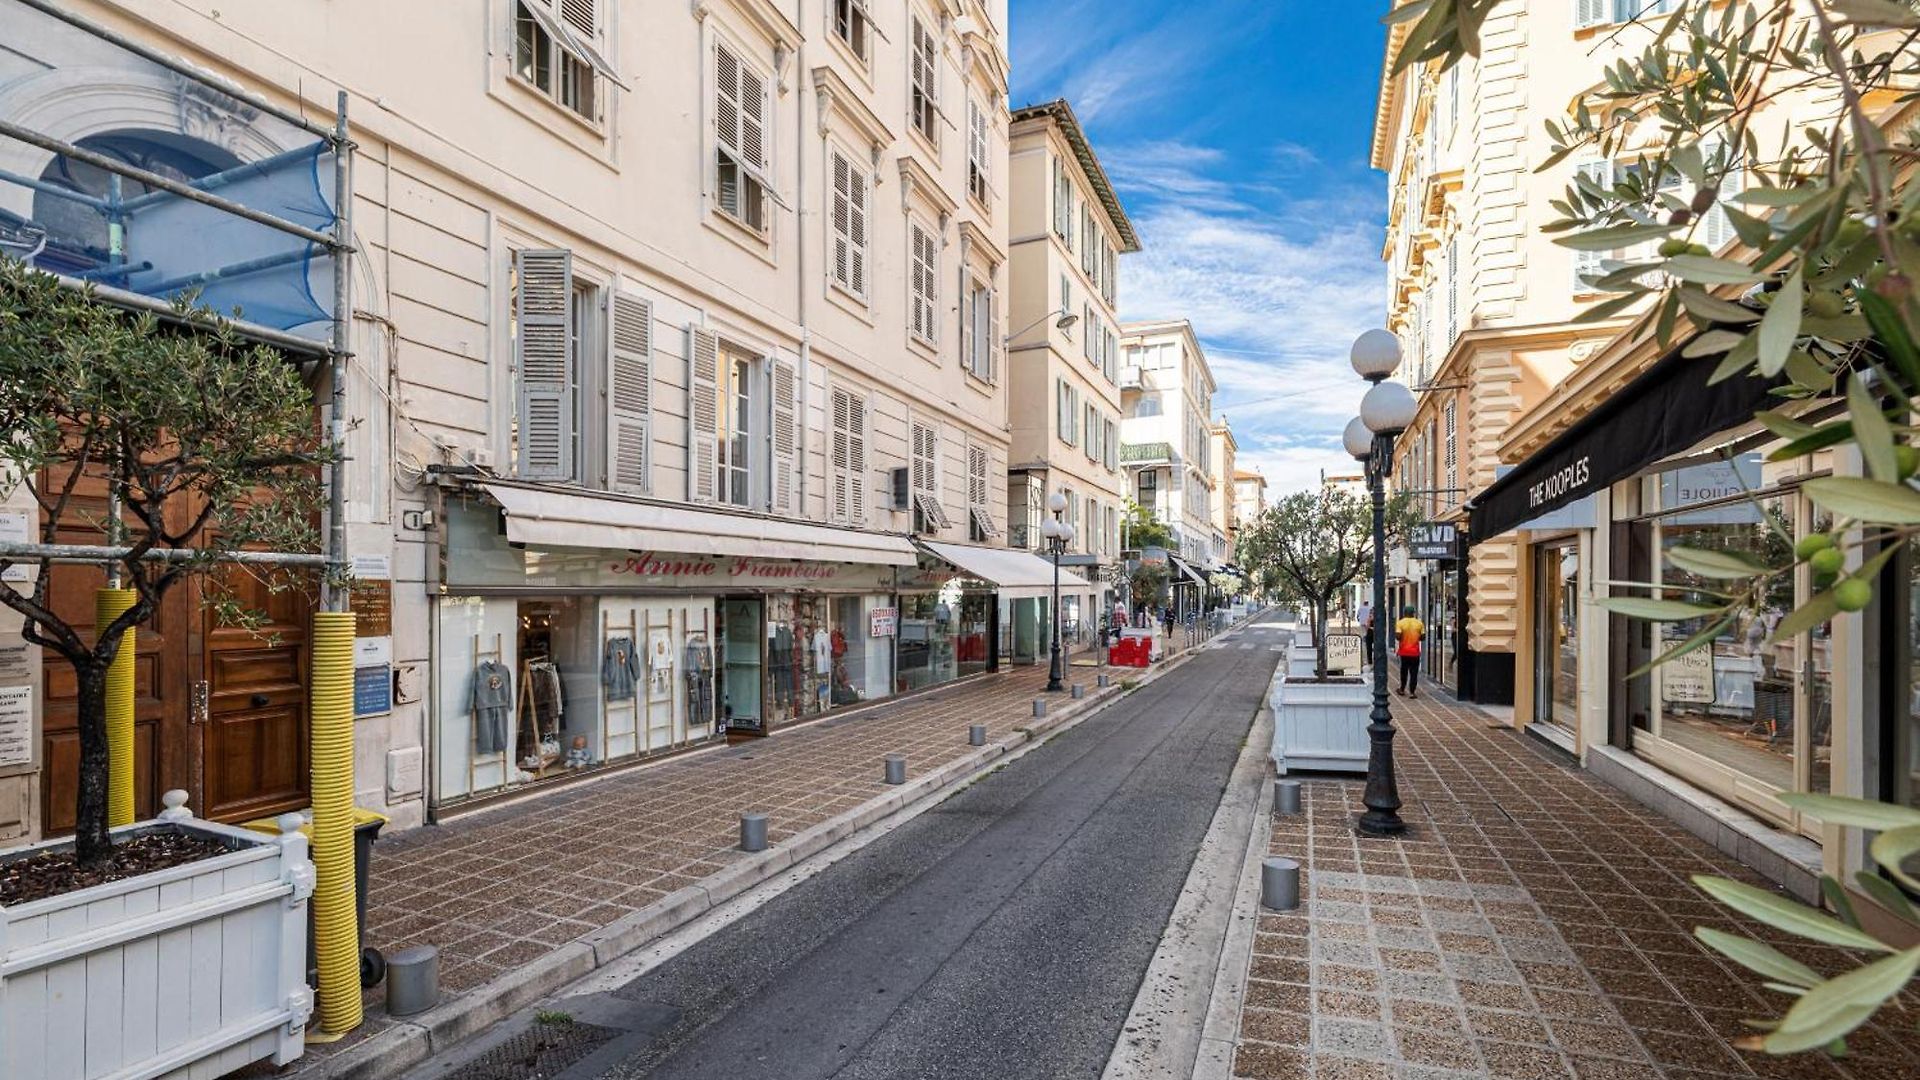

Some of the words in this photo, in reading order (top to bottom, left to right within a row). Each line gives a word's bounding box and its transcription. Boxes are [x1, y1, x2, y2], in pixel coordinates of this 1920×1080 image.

[1529, 482, 1544, 508] THE
[612, 551, 717, 576] Annie
[728, 556, 838, 578] Framboise
